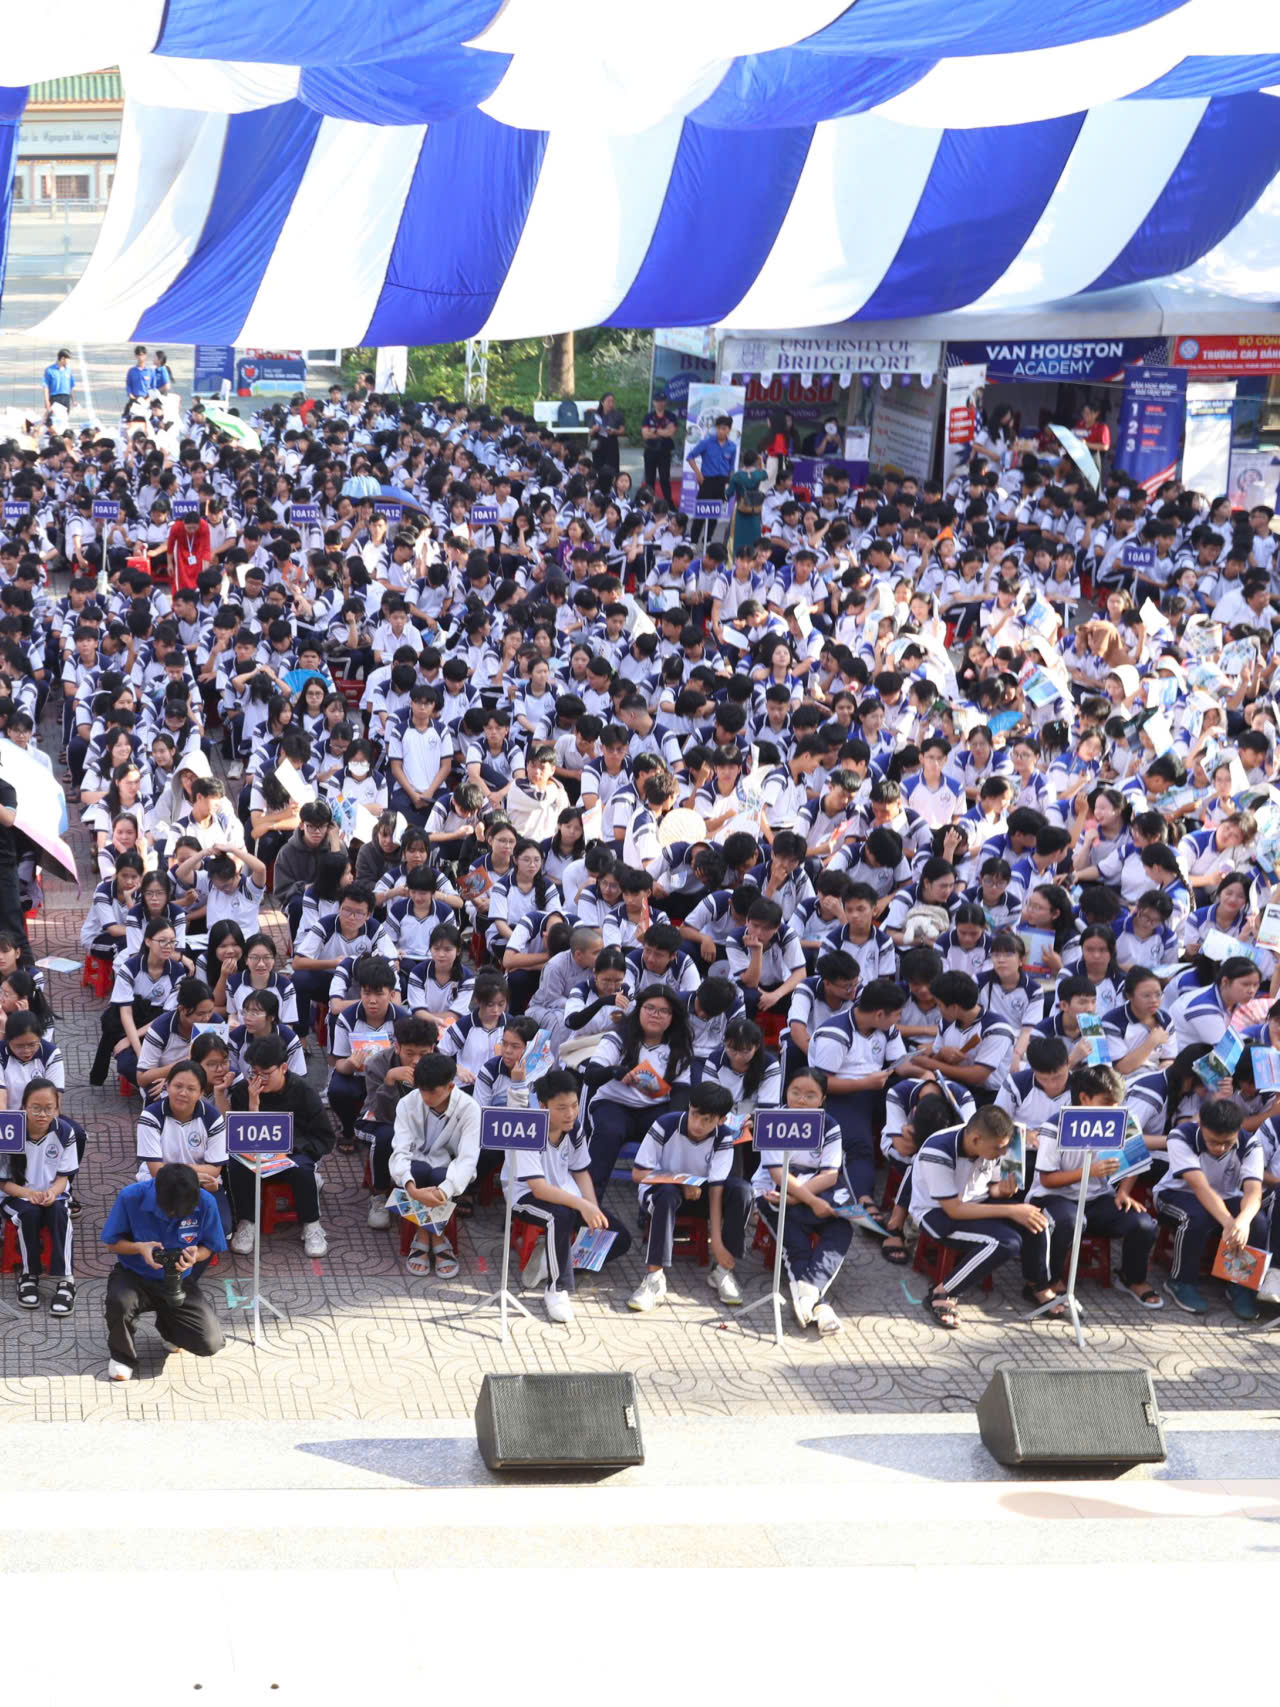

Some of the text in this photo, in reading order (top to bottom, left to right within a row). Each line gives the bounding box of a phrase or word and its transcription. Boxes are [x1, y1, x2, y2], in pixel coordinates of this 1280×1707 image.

[780, 339, 914, 352] UNIVERSITY OF
[986, 342, 1123, 360] VAN HOUSTON
[1240, 348, 1258, 360] CAO
[777, 354, 915, 370] BRIDGEPORT
[1013, 360, 1095, 376] ACADEMY
[1131, 403, 1138, 417] 1
[1128, 421, 1138, 435] 2
[1126, 439, 1136, 452] 3
[5, 507, 27, 515] 10A16
[94, 505, 117, 514] 10A15
[174, 505, 197, 514] 10A14
[292, 509, 315, 518] 10A13
[474, 510, 497, 519] 10A11
[696, 505, 720, 514] 10A10
[1127, 551, 1151, 562] 10A9
[236, 1125, 282, 1141] 10A5
[491, 1121, 537, 1139] 10A4
[765, 1122, 812, 1139] 10A3
[1069, 1120, 1116, 1138] 10A2
